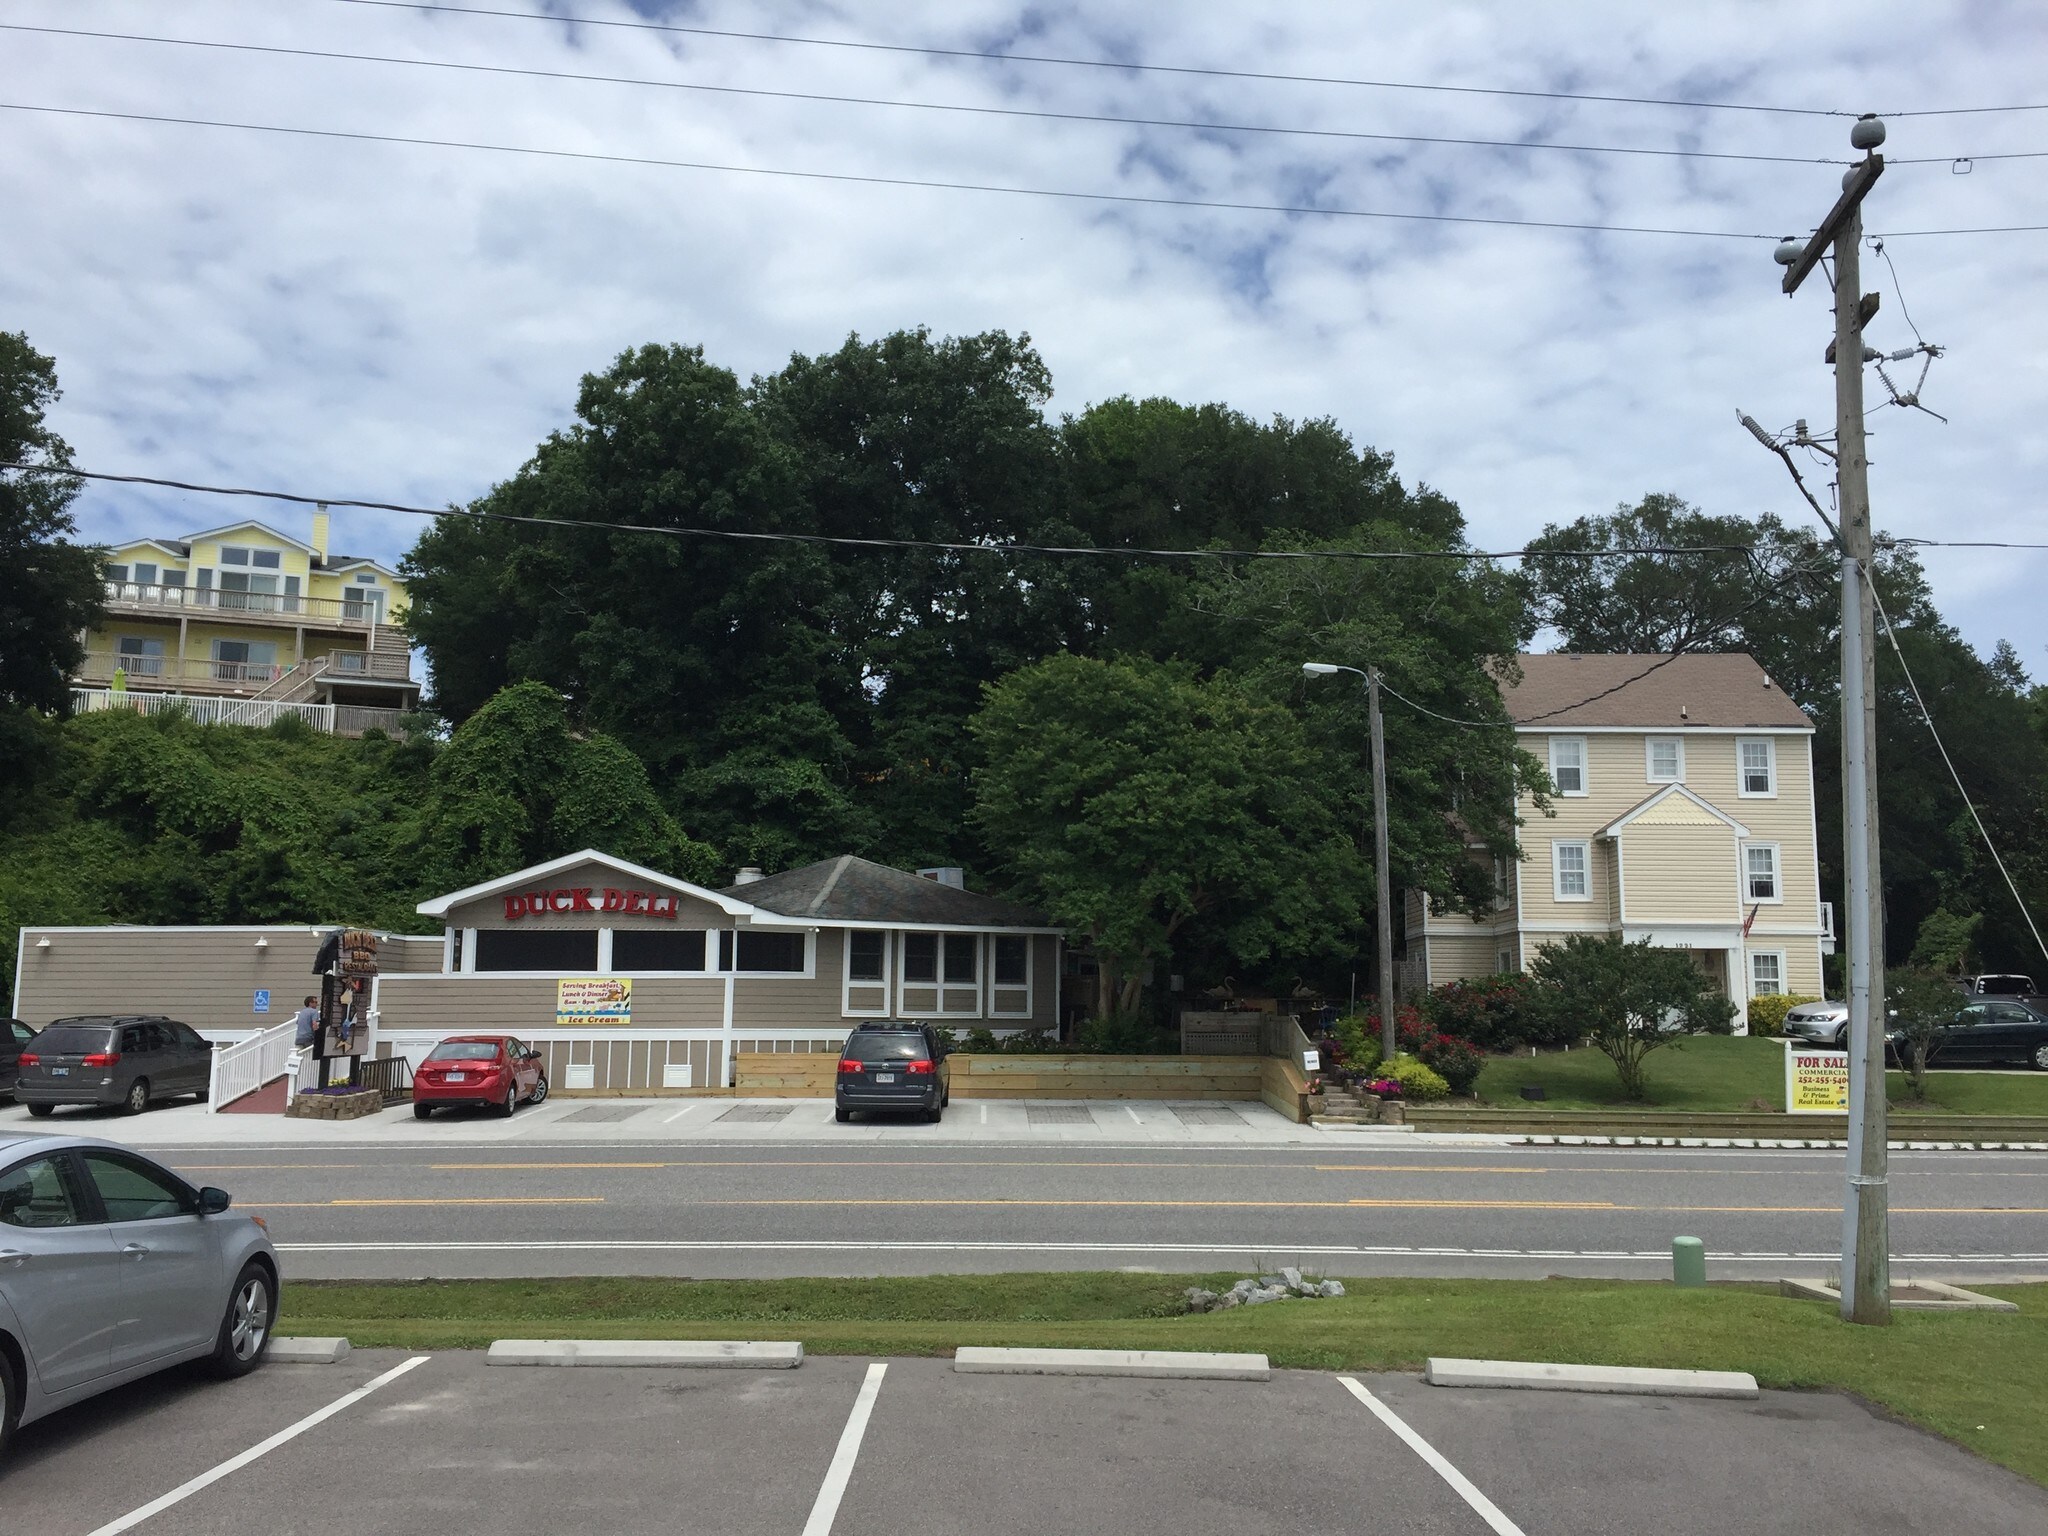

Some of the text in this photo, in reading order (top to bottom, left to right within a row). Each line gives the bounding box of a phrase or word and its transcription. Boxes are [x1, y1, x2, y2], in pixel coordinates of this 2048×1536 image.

[504, 887, 678, 920] DUCK DELI
[1797, 1057, 1848, 1068] FOR SAL
